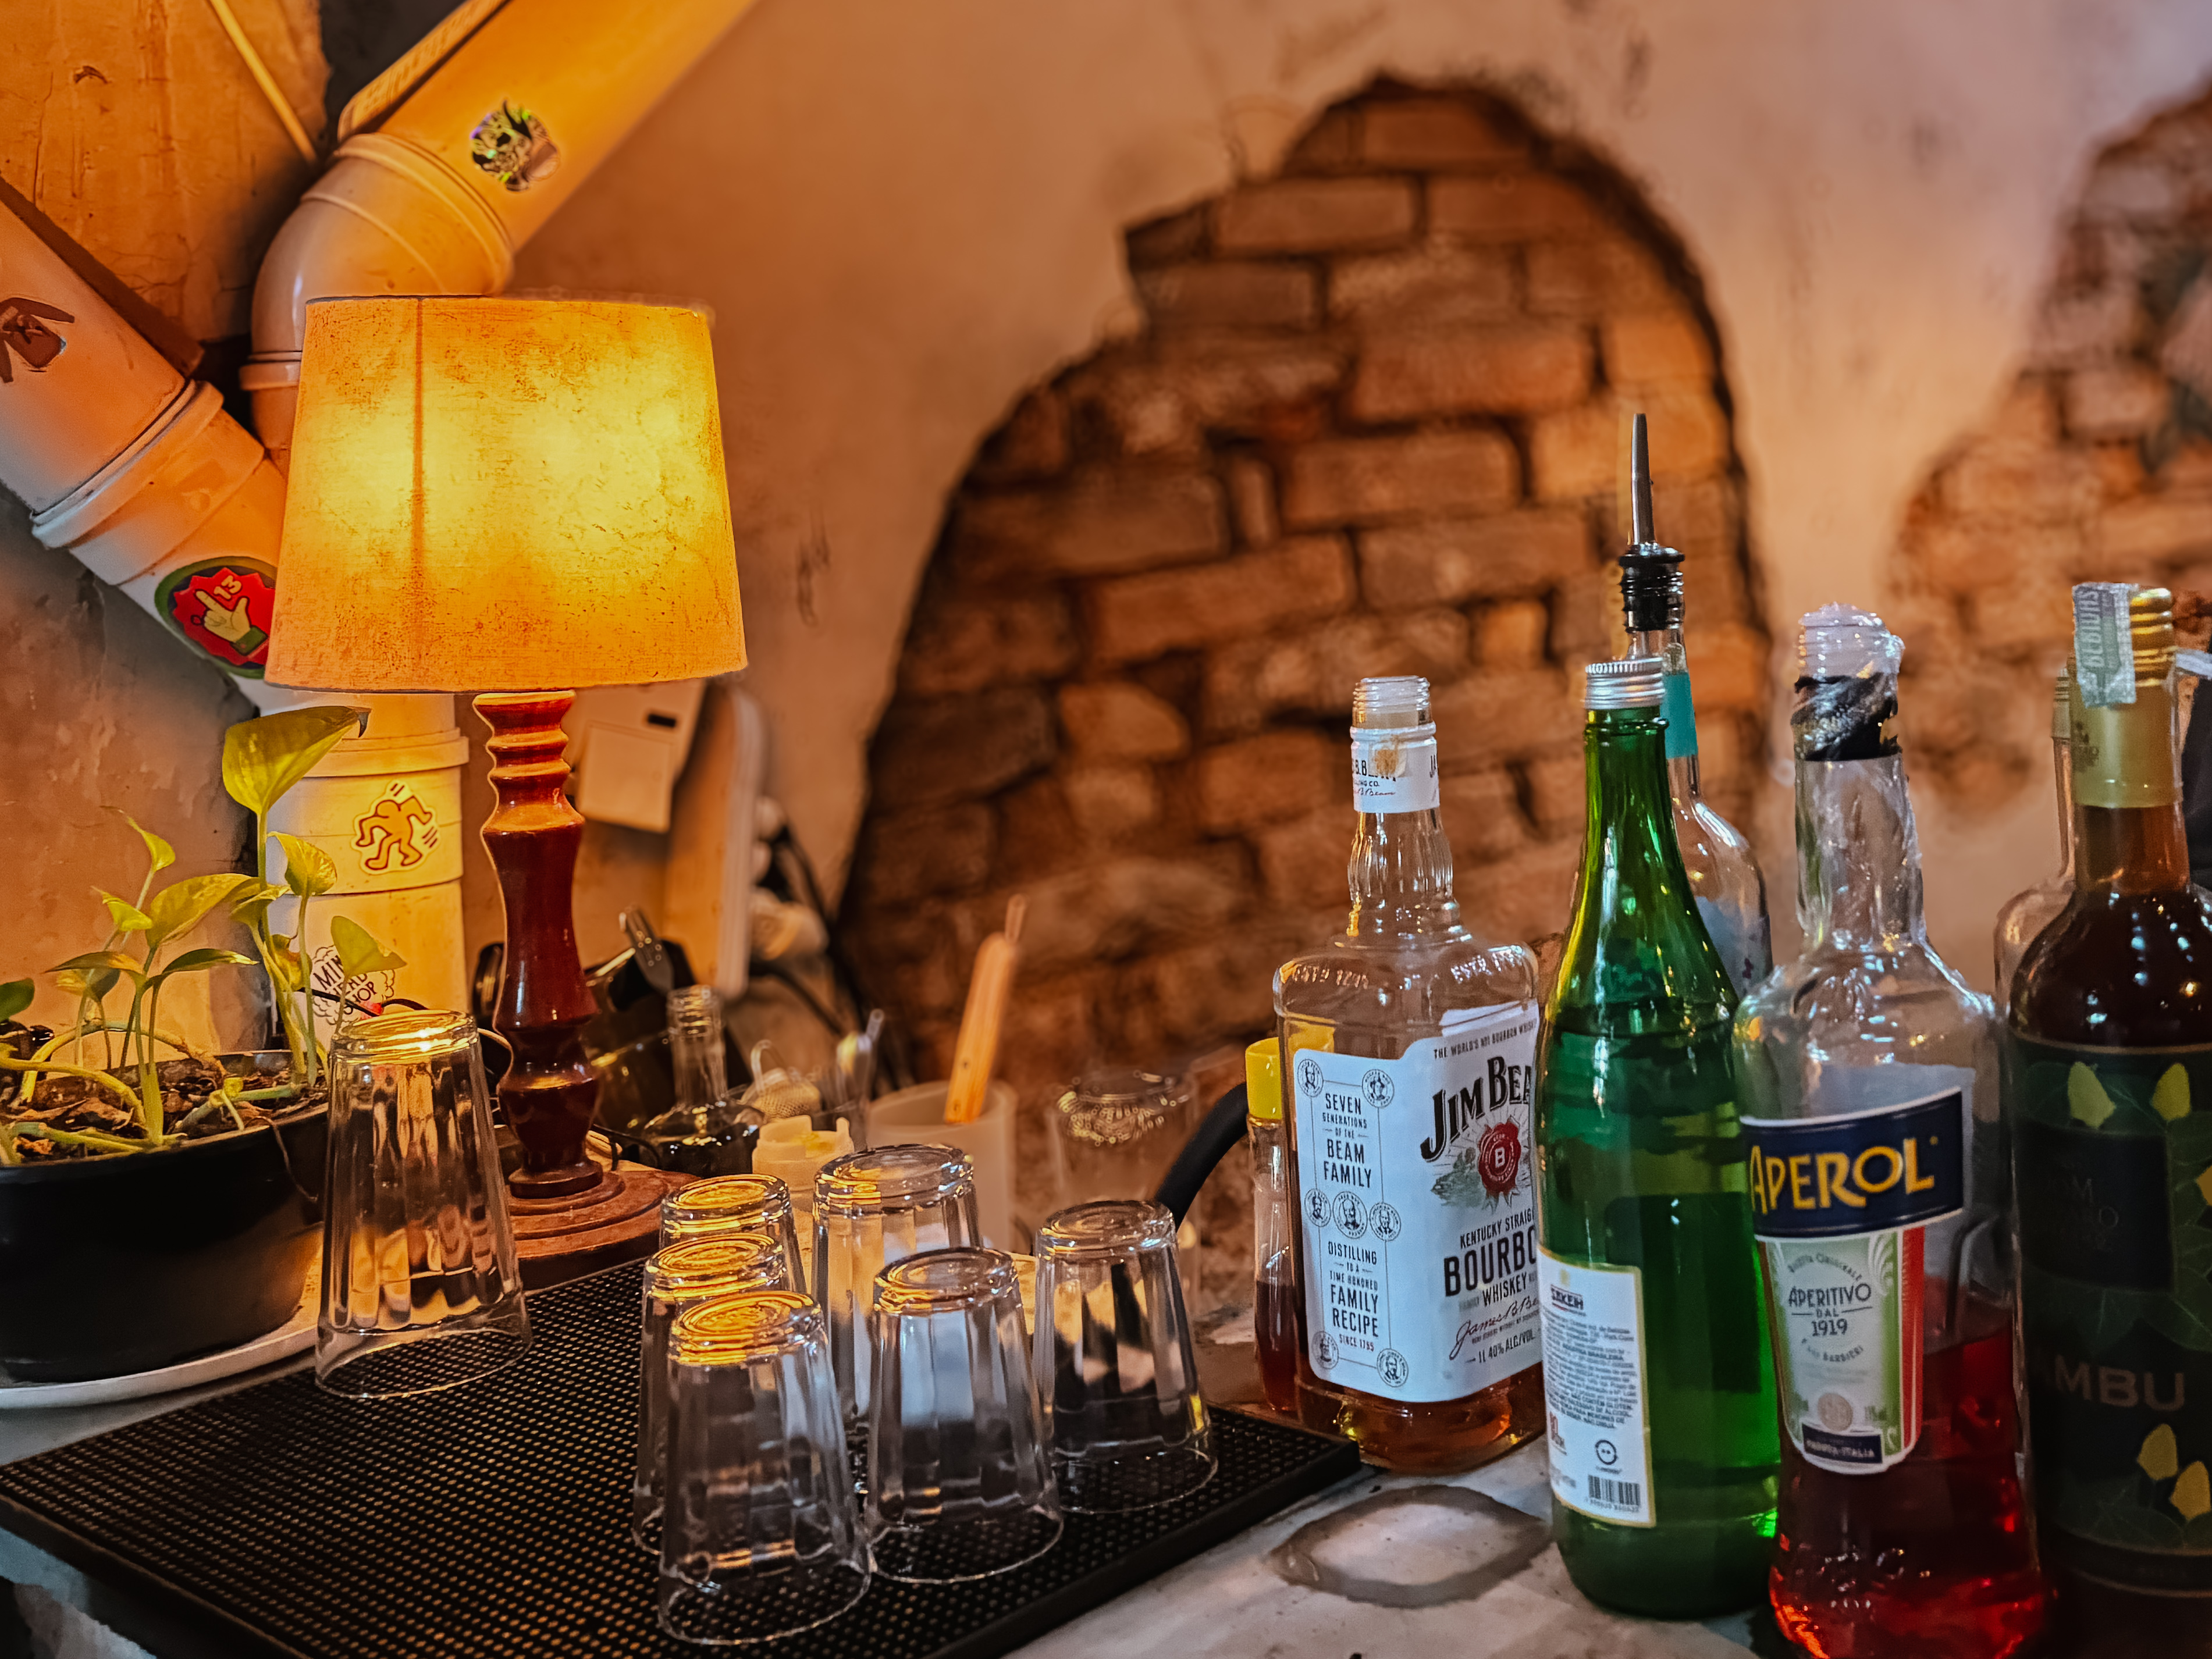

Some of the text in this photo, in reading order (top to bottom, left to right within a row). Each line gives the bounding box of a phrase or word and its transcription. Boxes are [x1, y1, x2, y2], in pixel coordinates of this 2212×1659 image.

[1325, 1093, 1361, 1115] SEVEN
[1322, 1112, 1367, 1129] GENERATIONS
[1420, 1077, 1486, 1163] JIM
[1327, 1138, 1365, 1164] BEAM
[1324, 1160, 1372, 1188] FAMILY
[1749, 1138, 1935, 1215] APEROL
[1460, 1219, 1502, 1249] KENTUCKY
[1328, 1241, 1377, 1265] DISTILLING
[1329, 1270, 1345, 1283] TIME
[1482, 1271, 1527, 1307] WHISKEY
[1331, 1284, 1378, 1314] FAMILY
[1788, 1283, 1872, 1308] APERITIVO
[1333, 1308, 1379, 1338] RECIPE
[1816, 1308, 1839, 1318] DAL
[1811, 1318, 1848, 1337] 1919
